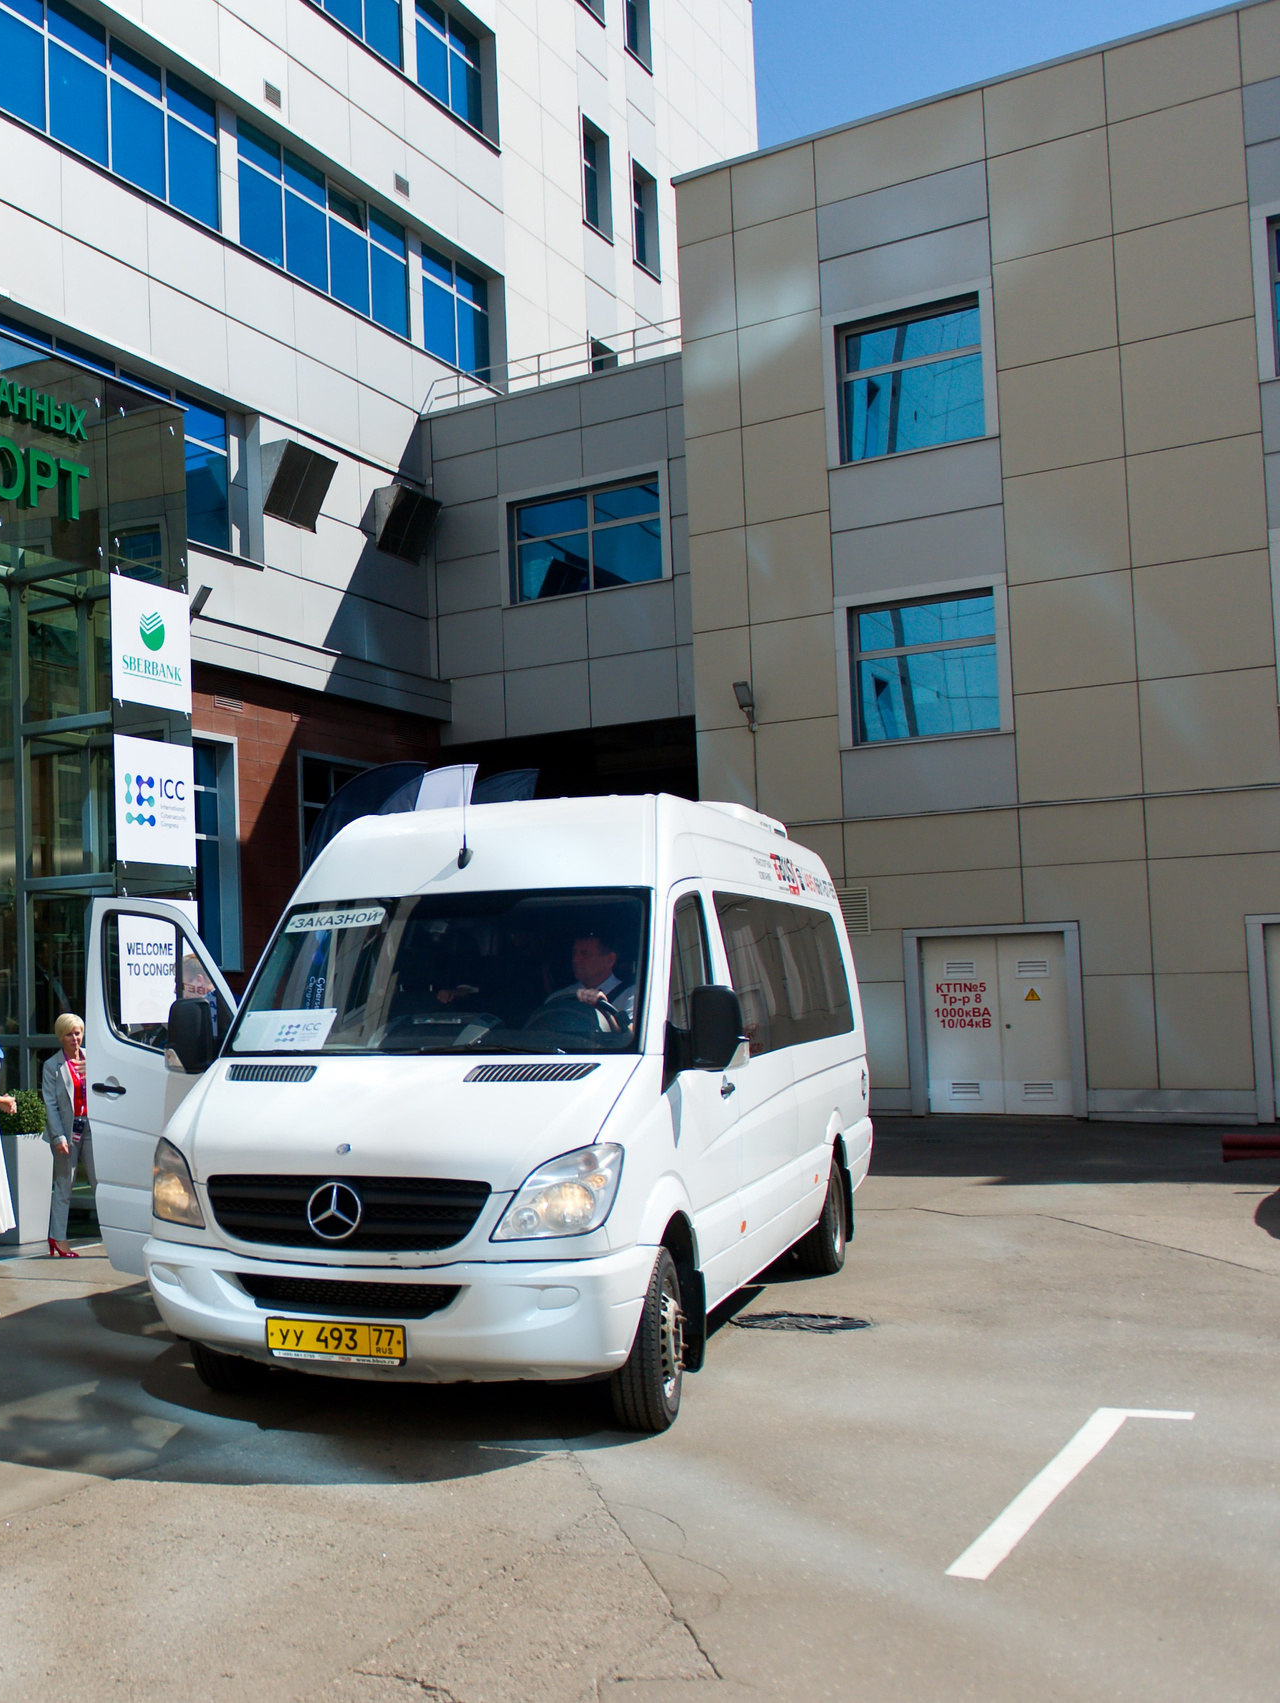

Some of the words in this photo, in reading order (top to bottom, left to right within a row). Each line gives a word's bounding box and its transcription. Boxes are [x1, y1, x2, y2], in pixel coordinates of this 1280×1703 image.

[122, 654, 182, 682] SBERBANK
[159, 777, 185, 801] ICC
[126, 942, 173, 956] WELCOME
[127, 963, 141, 976] TO
[143, 963, 176, 976] CONGR
[936, 982, 987, 994] КТП№5
[941, 994, 970, 1006] Тр-р
[974, 994, 982, 1004] 8
[934, 1007, 992, 1018] 1000кВА
[940, 1018, 992, 1029] 10/04кВ
[315, 1326, 358, 1350] 493
[372, 1328, 395, 1347] 77
[375, 1347, 393, 1355] RUS
